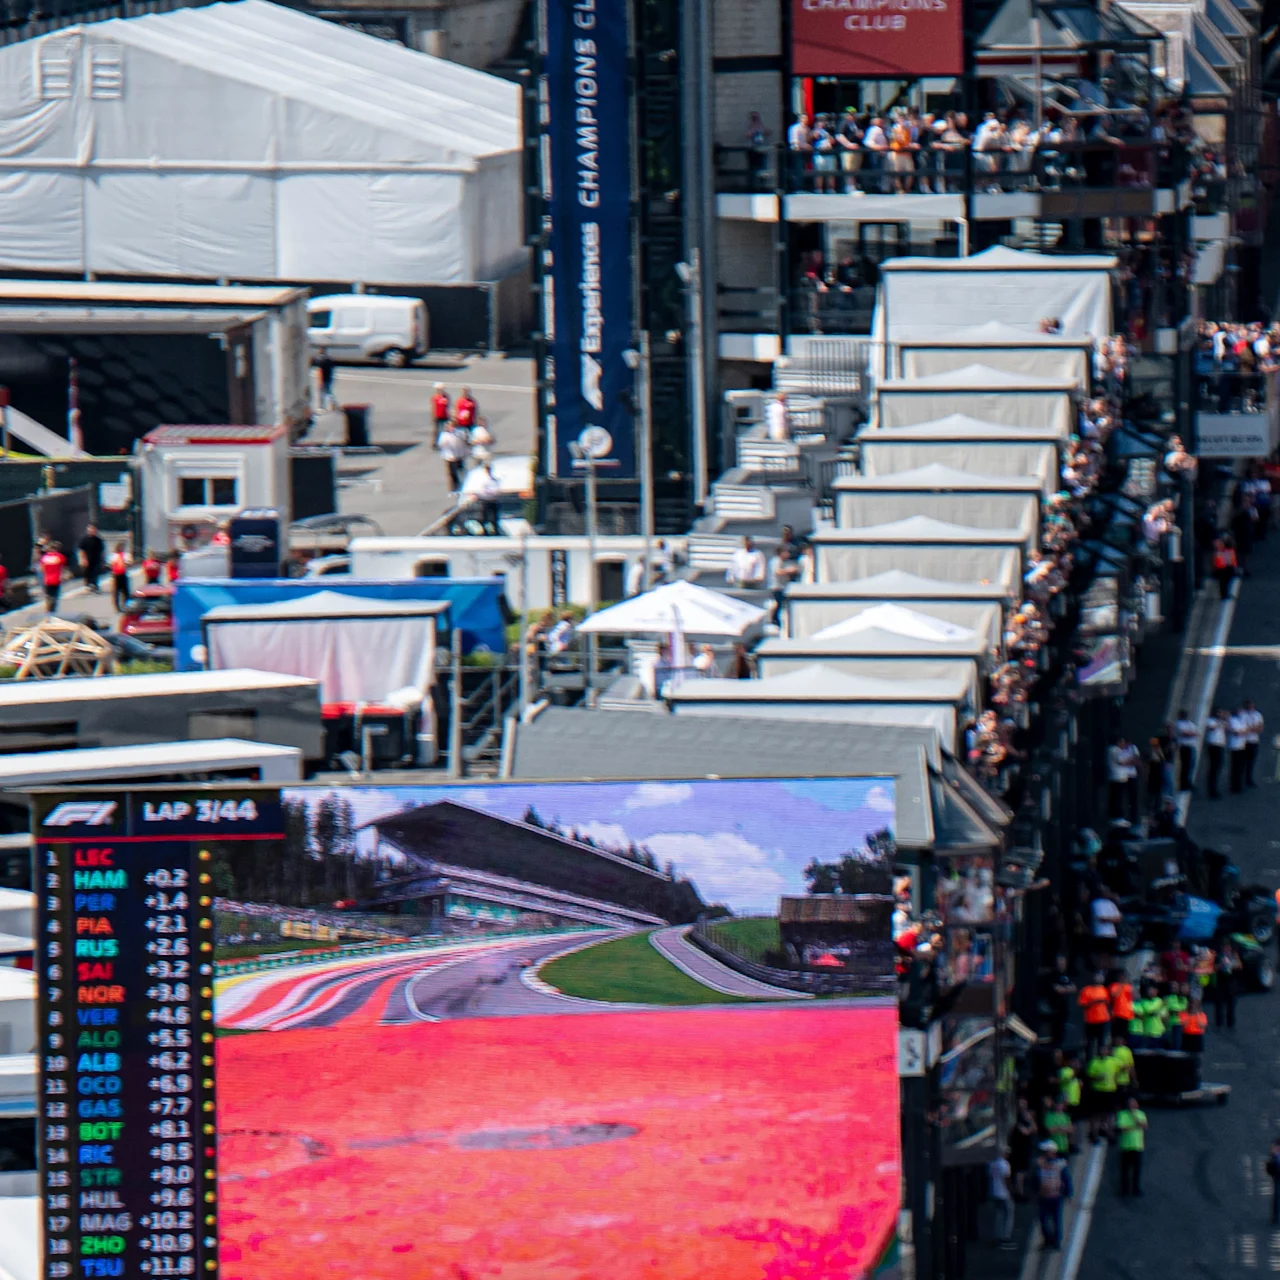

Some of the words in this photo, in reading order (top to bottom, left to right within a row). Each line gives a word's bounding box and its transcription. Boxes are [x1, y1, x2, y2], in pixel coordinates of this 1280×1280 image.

[843, 14, 908, 31] CLUB
[574, 37, 601, 209] CHAMPIONS
[579, 221, 604, 353] Experiences
[143, 801, 192, 822] LAP
[195, 798, 259, 823] 3/44
[75, 849, 113, 866] LEC
[74, 869, 126, 889] HAM
[75, 893, 116, 911] PER
[77, 918, 113, 933] PIA
[75, 939, 118, 956] RUS
[78, 963, 113, 980] SAI
[78, 985, 125, 1003] NOR
[77, 1008, 119, 1025] VER
[77, 1053, 120, 1072] ALB
[78, 1099, 123, 1117] GAS
[80, 1122, 123, 1140] BOT
[78, 1145, 113, 1163] RIC
[79, 1191, 125, 1208] HUL
[80, 1213, 133, 1231] MAG
[81, 1236, 126, 1254] ZHO
[80, 1258, 124, 1276] TSU
